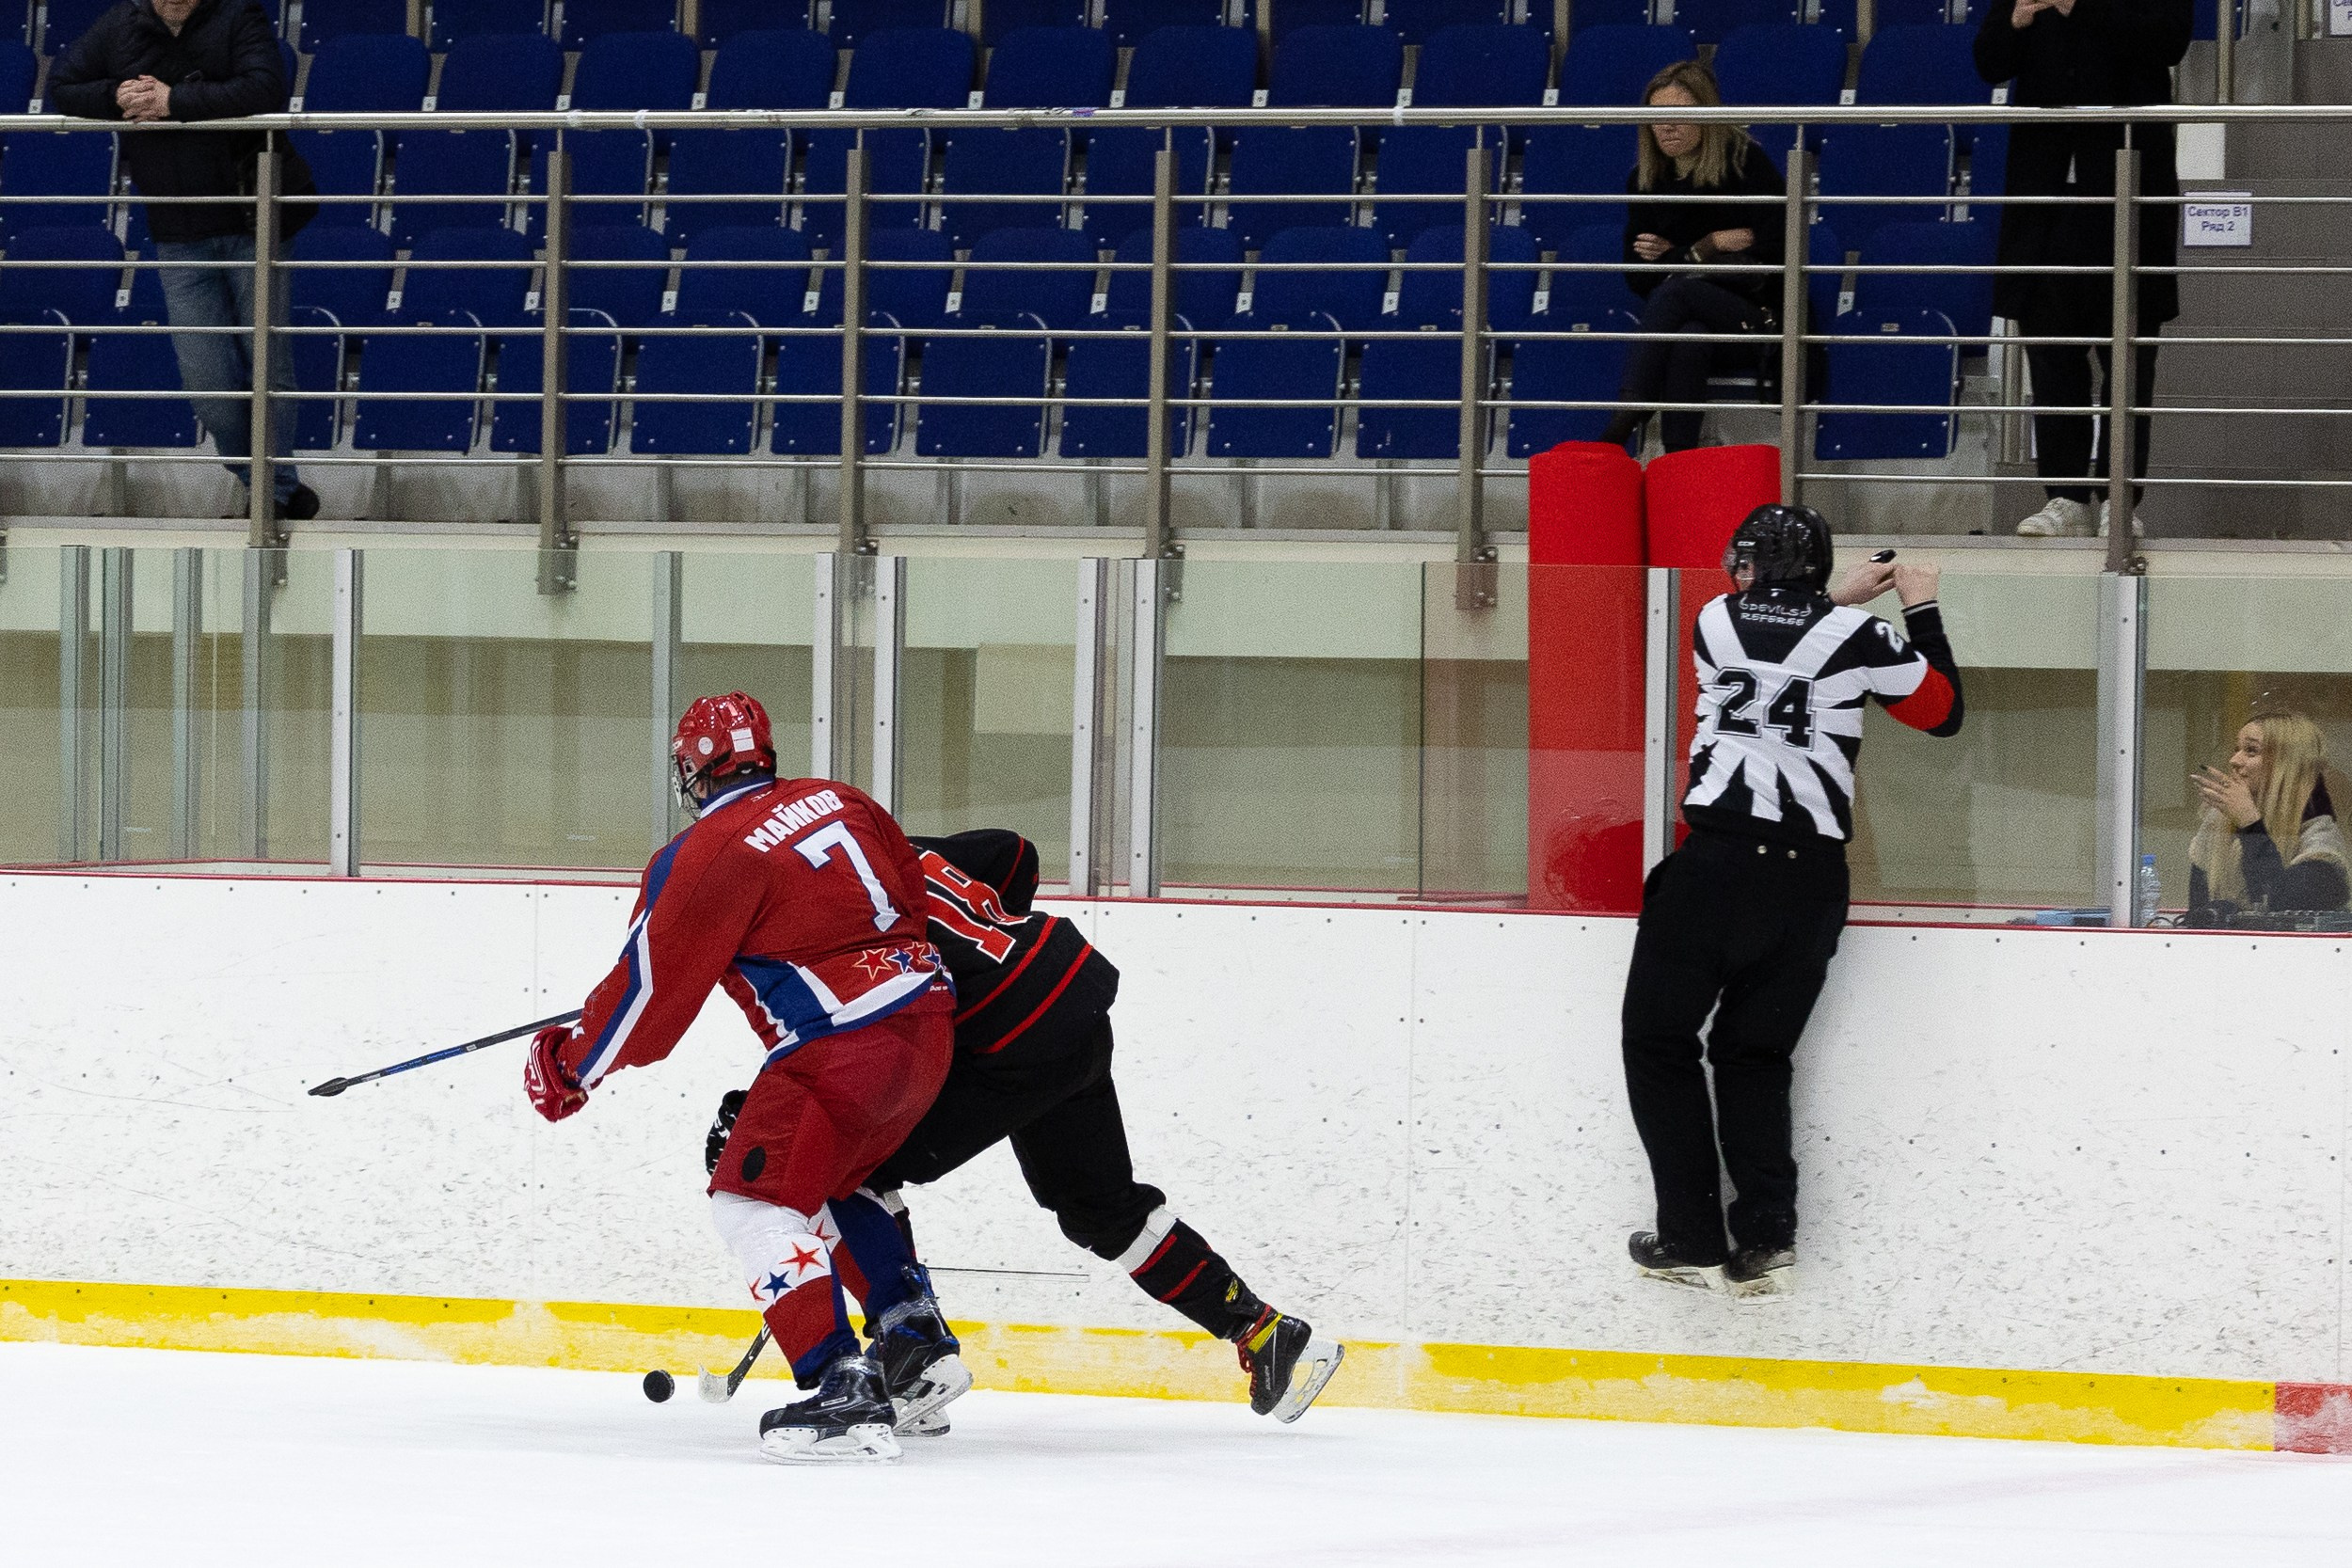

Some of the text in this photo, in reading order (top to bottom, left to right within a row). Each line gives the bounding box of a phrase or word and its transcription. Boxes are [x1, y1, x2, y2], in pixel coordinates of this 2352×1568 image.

[2187, 206, 2231, 218] Сектор
[2201, 220, 2235, 232] Ряд 2
[1740, 612, 1806, 626] REFEREE
[1713, 666, 1817, 752] 24
[743, 789, 845, 853] МАЙКОВ
[792, 818, 902, 933] 7
